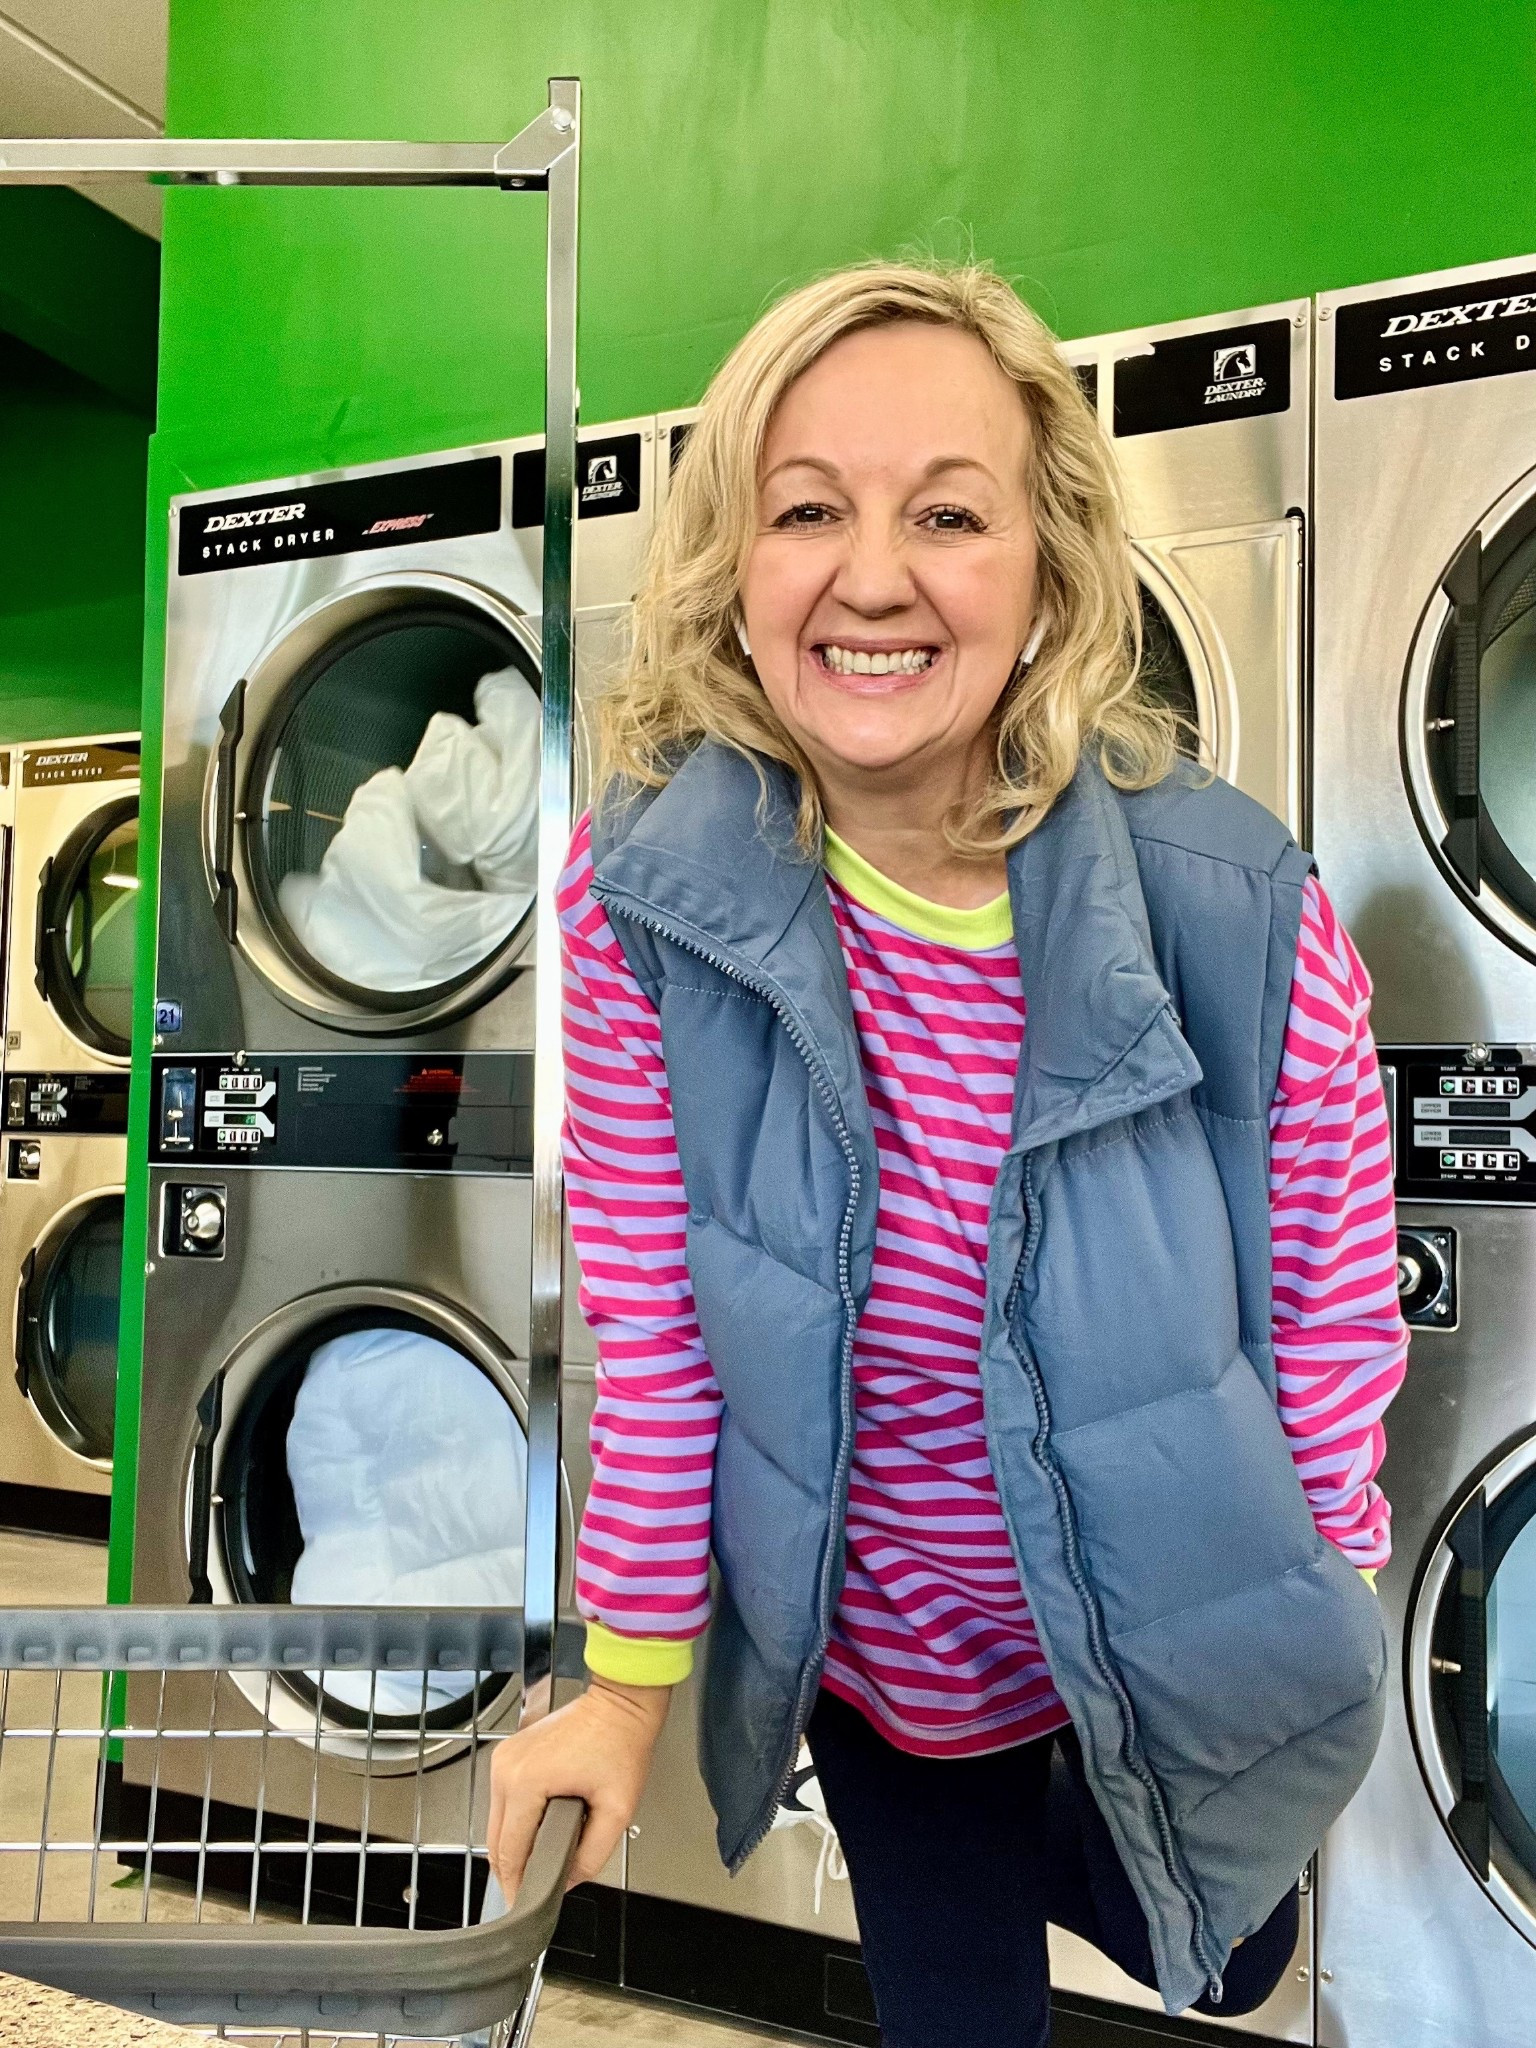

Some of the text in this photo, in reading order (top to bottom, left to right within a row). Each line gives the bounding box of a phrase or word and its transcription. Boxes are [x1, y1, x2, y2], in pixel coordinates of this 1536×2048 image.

[1380, 293, 1536, 337] DEXTE
[1379, 342, 1485, 372] STACK
[1204, 377, 1264, 395] DEXTER
[1204, 387, 1266, 405] LAUNDRY
[203, 503, 306, 533] DEXTER
[202, 528, 334, 559] STACK DRYER
[36, 752, 88, 766] DEXTER
[159, 1008, 174, 1024] 21
